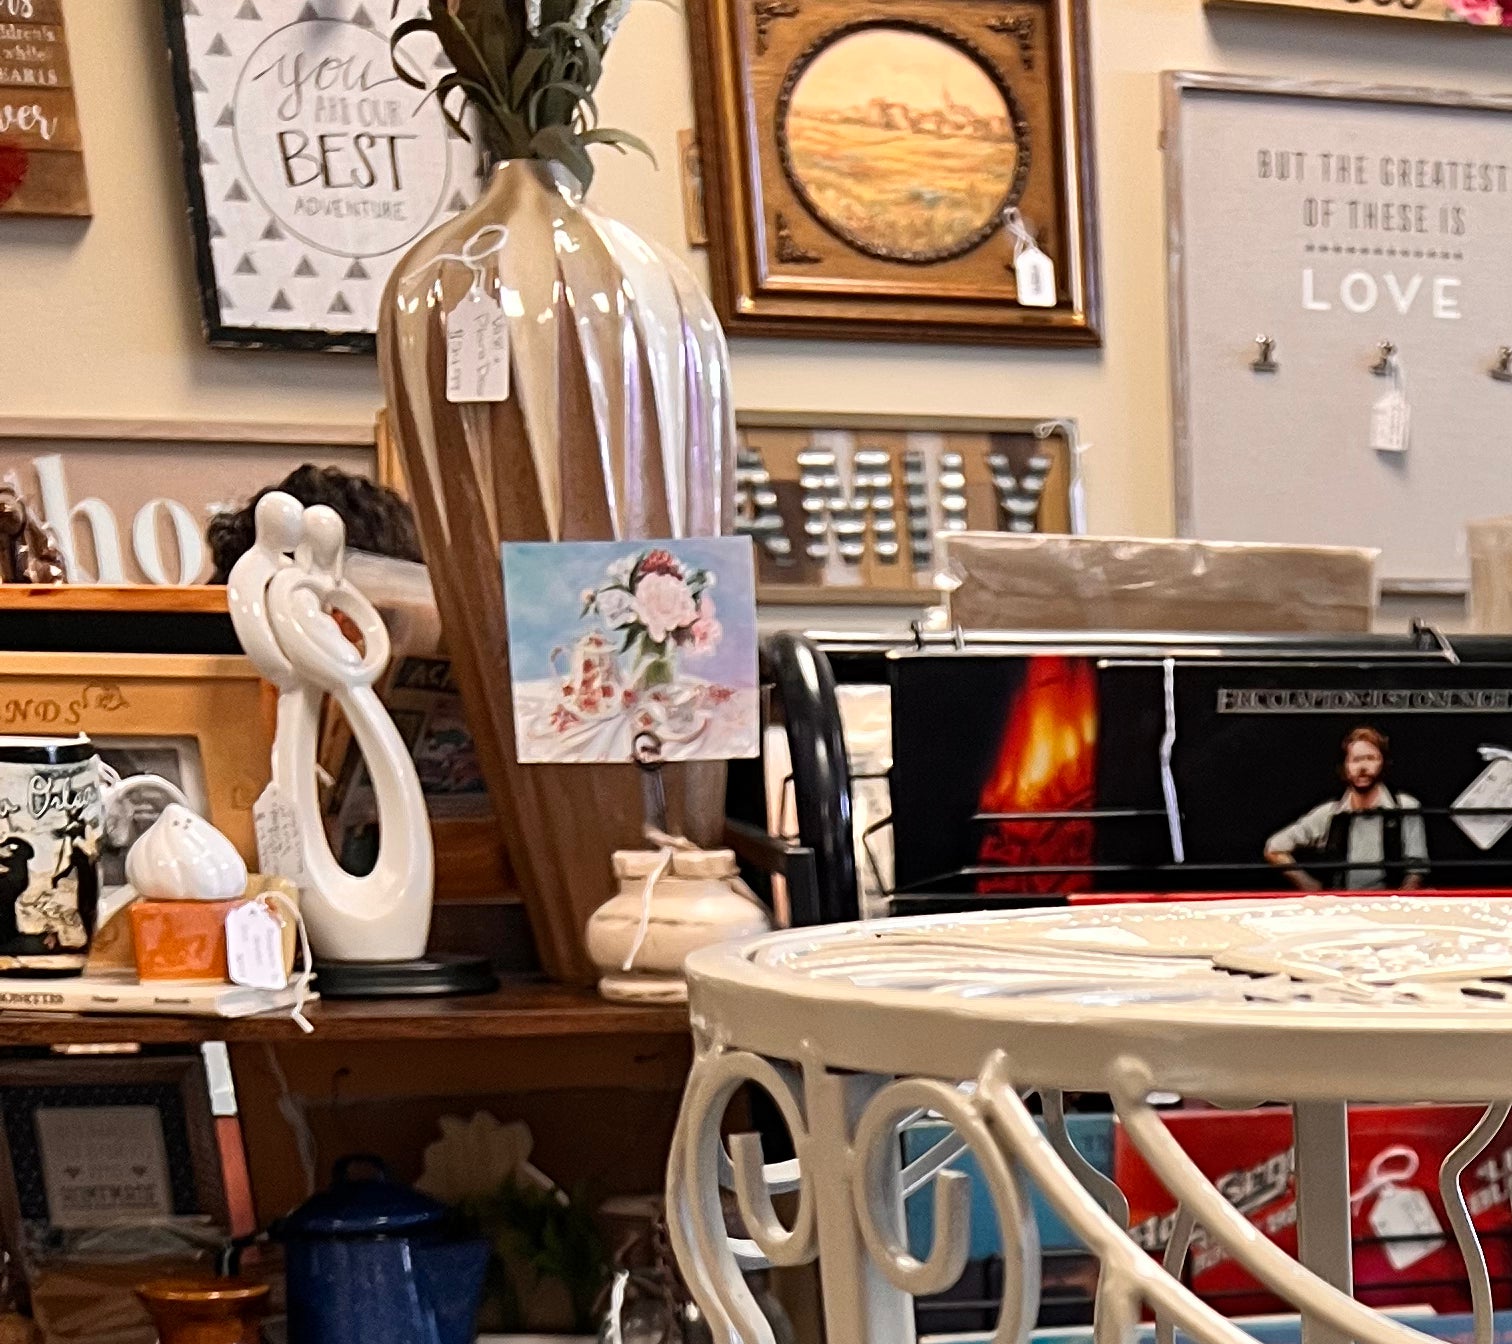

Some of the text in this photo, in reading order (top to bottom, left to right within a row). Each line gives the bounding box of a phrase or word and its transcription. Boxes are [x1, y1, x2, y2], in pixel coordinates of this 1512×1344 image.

[252, 52, 401, 122] you
[276, 129, 421, 192] BEST
[1257, 149, 1510, 193] BUT THE GREATEST
[293, 196, 408, 221] ADVENTURE
[1303, 197, 1466, 236] OF THESE IS
[1302, 268, 1463, 320] LOVE
